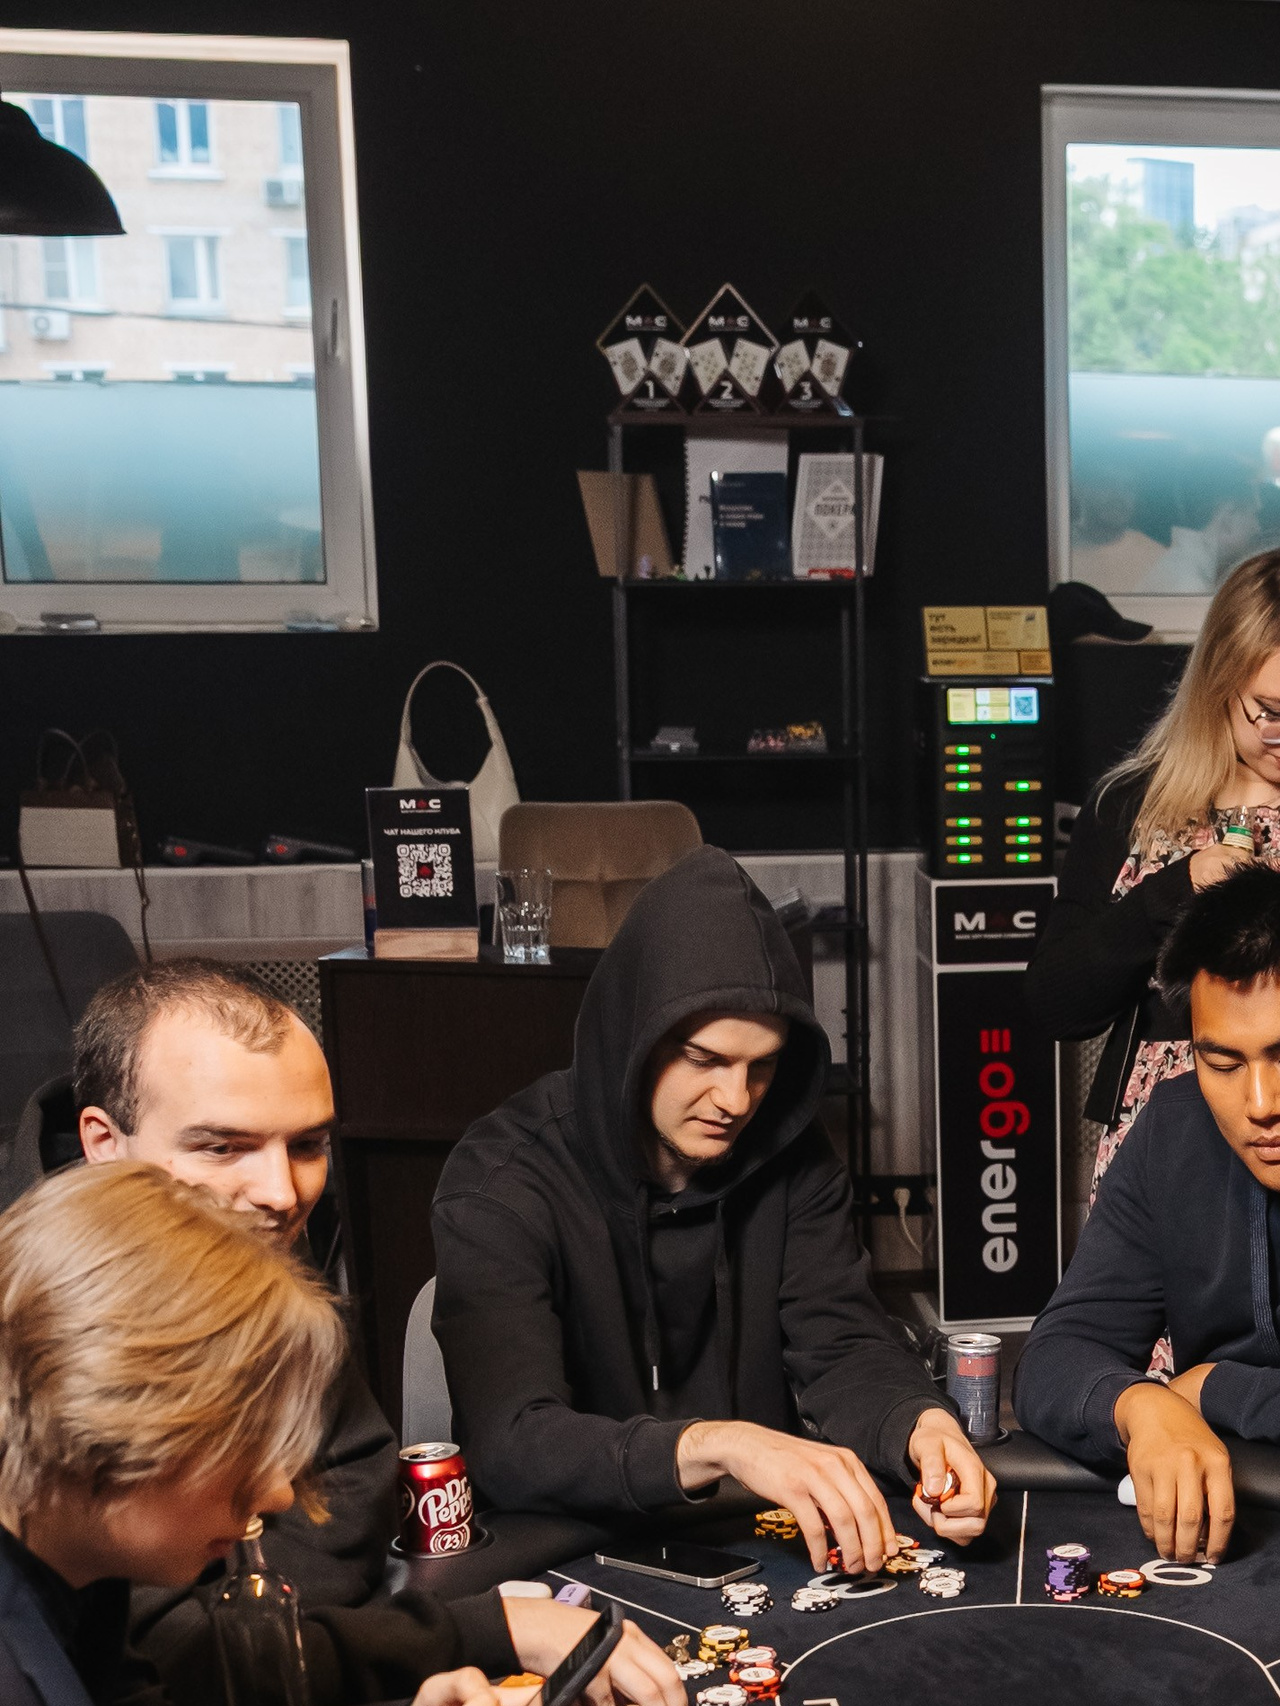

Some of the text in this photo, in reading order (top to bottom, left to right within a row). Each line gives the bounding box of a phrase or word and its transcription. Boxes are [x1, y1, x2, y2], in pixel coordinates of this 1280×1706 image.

[644, 381, 654, 399] 1
[720, 381, 733, 399] 2
[800, 381, 811, 399] 3
[446, 1476, 468, 1501] Dr
[418, 1486, 472, 1529] Pepp
[443, 1534, 461, 1550] 23
